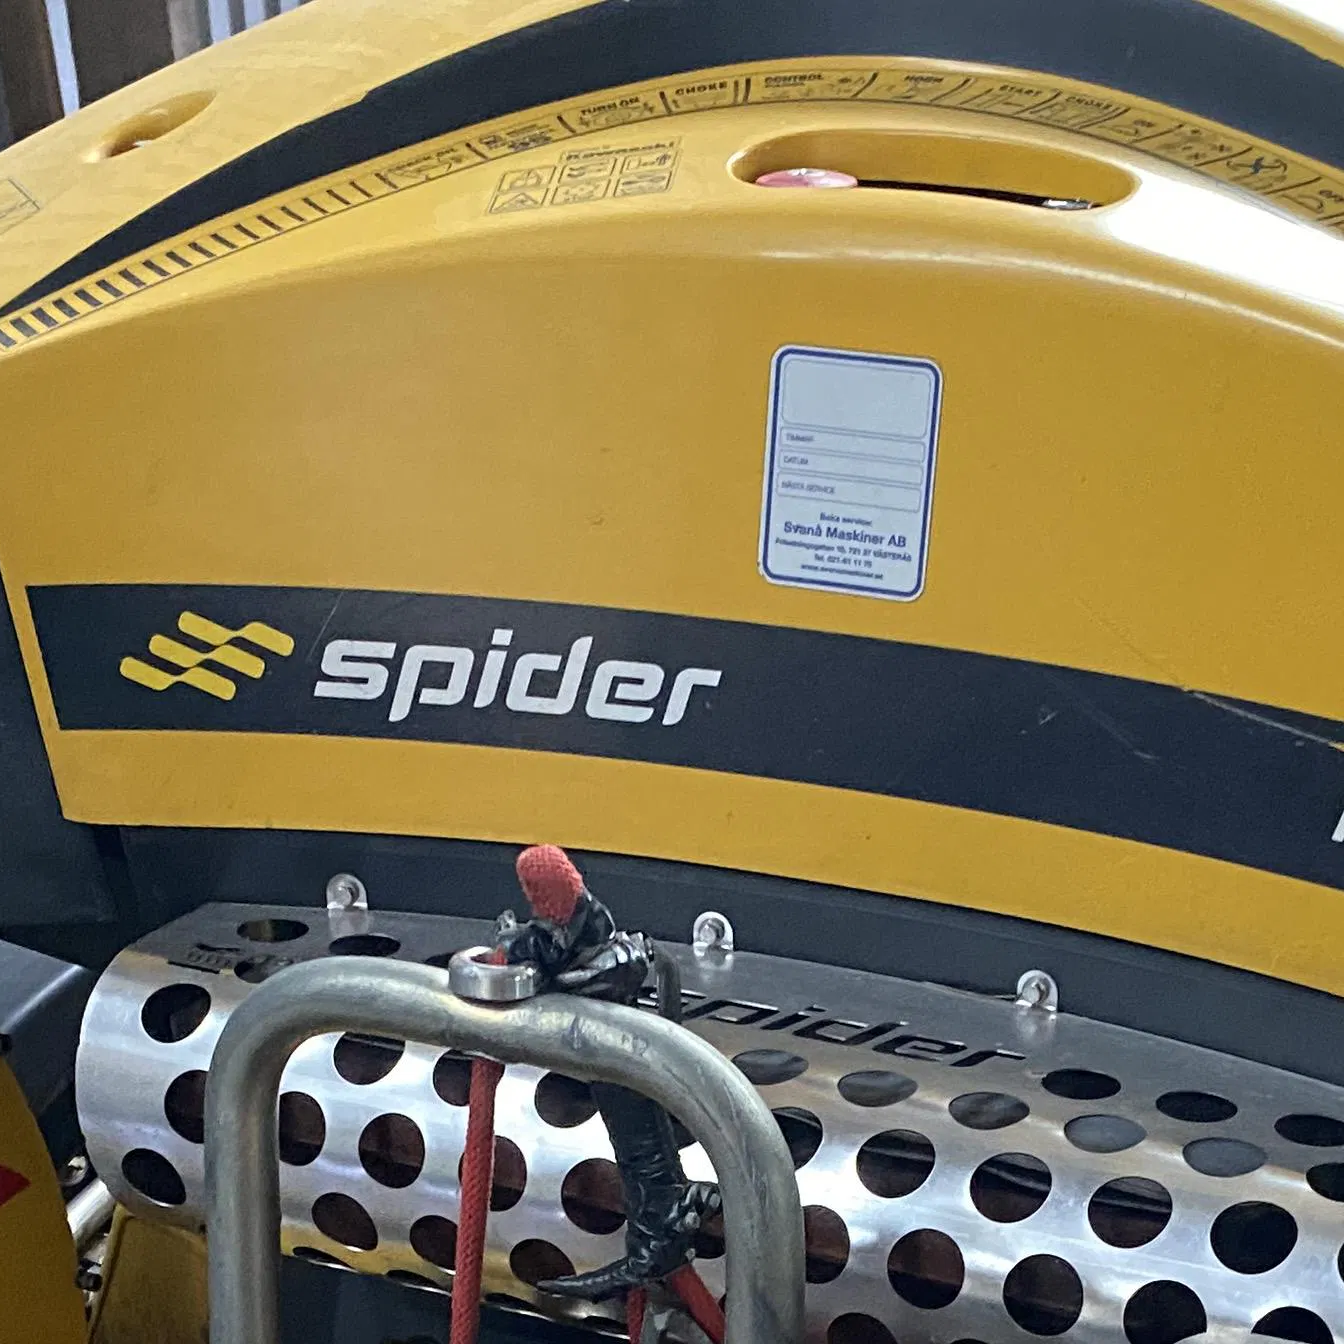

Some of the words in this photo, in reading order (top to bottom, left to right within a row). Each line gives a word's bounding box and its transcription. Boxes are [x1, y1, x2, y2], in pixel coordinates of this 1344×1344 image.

[674, 80, 728, 96] CHOKE
[998, 84, 1043, 98] START
[784, 521, 823, 537] Svanå
[825, 526, 885, 546] Maskiner
[888, 532, 907, 548] AB
[313, 627, 722, 727] spider
